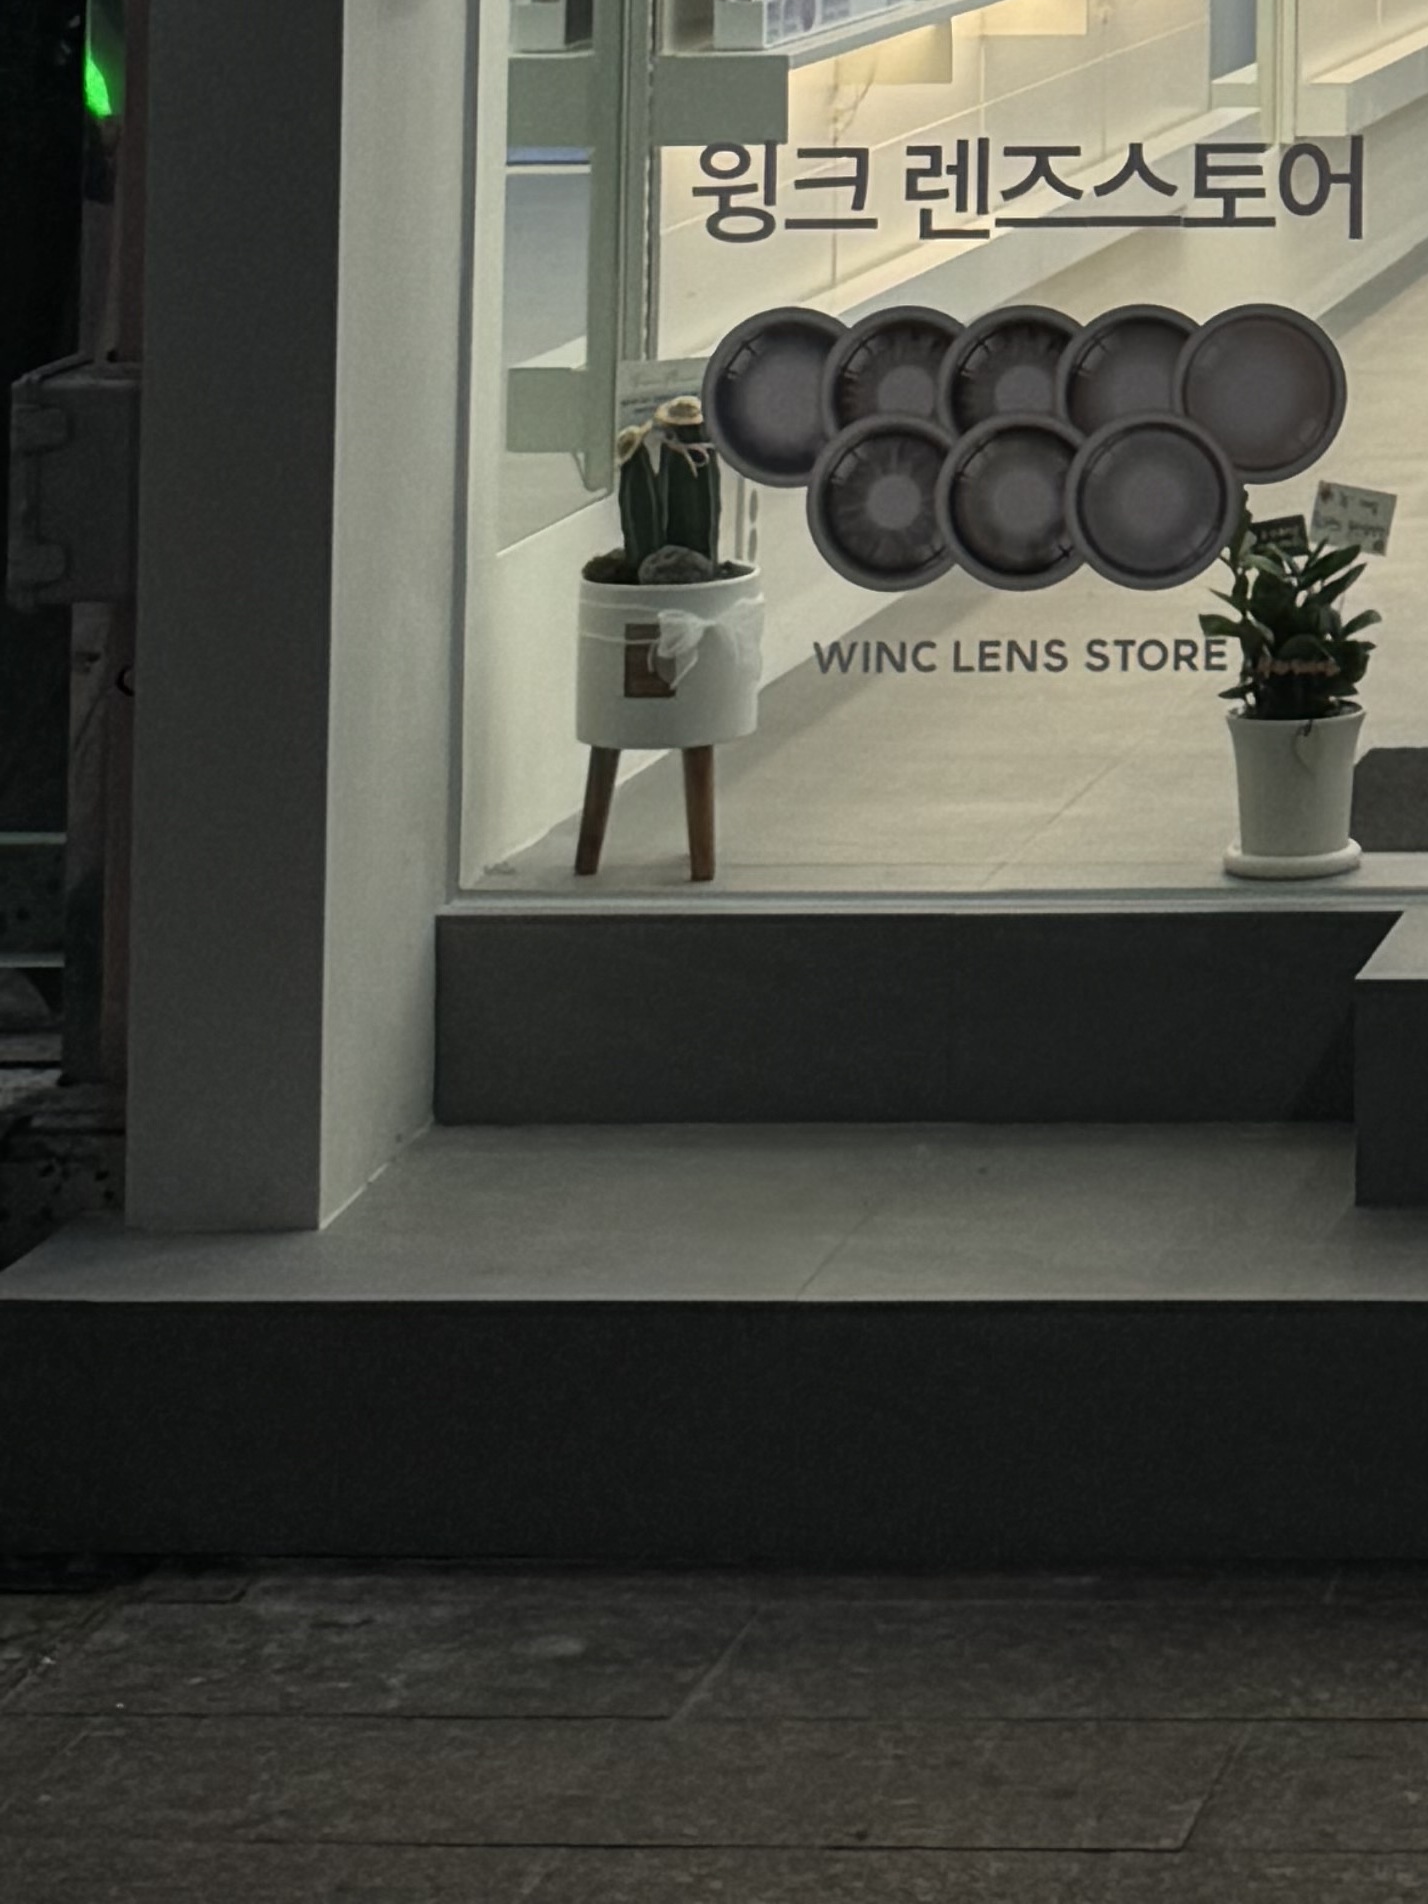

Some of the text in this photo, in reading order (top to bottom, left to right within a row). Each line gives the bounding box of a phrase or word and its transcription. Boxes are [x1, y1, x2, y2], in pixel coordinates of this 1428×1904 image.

[690, 135, 1365, 245] 윙크 렌즈스토어
[812, 637, 1229, 676] WINC LENS STORE
